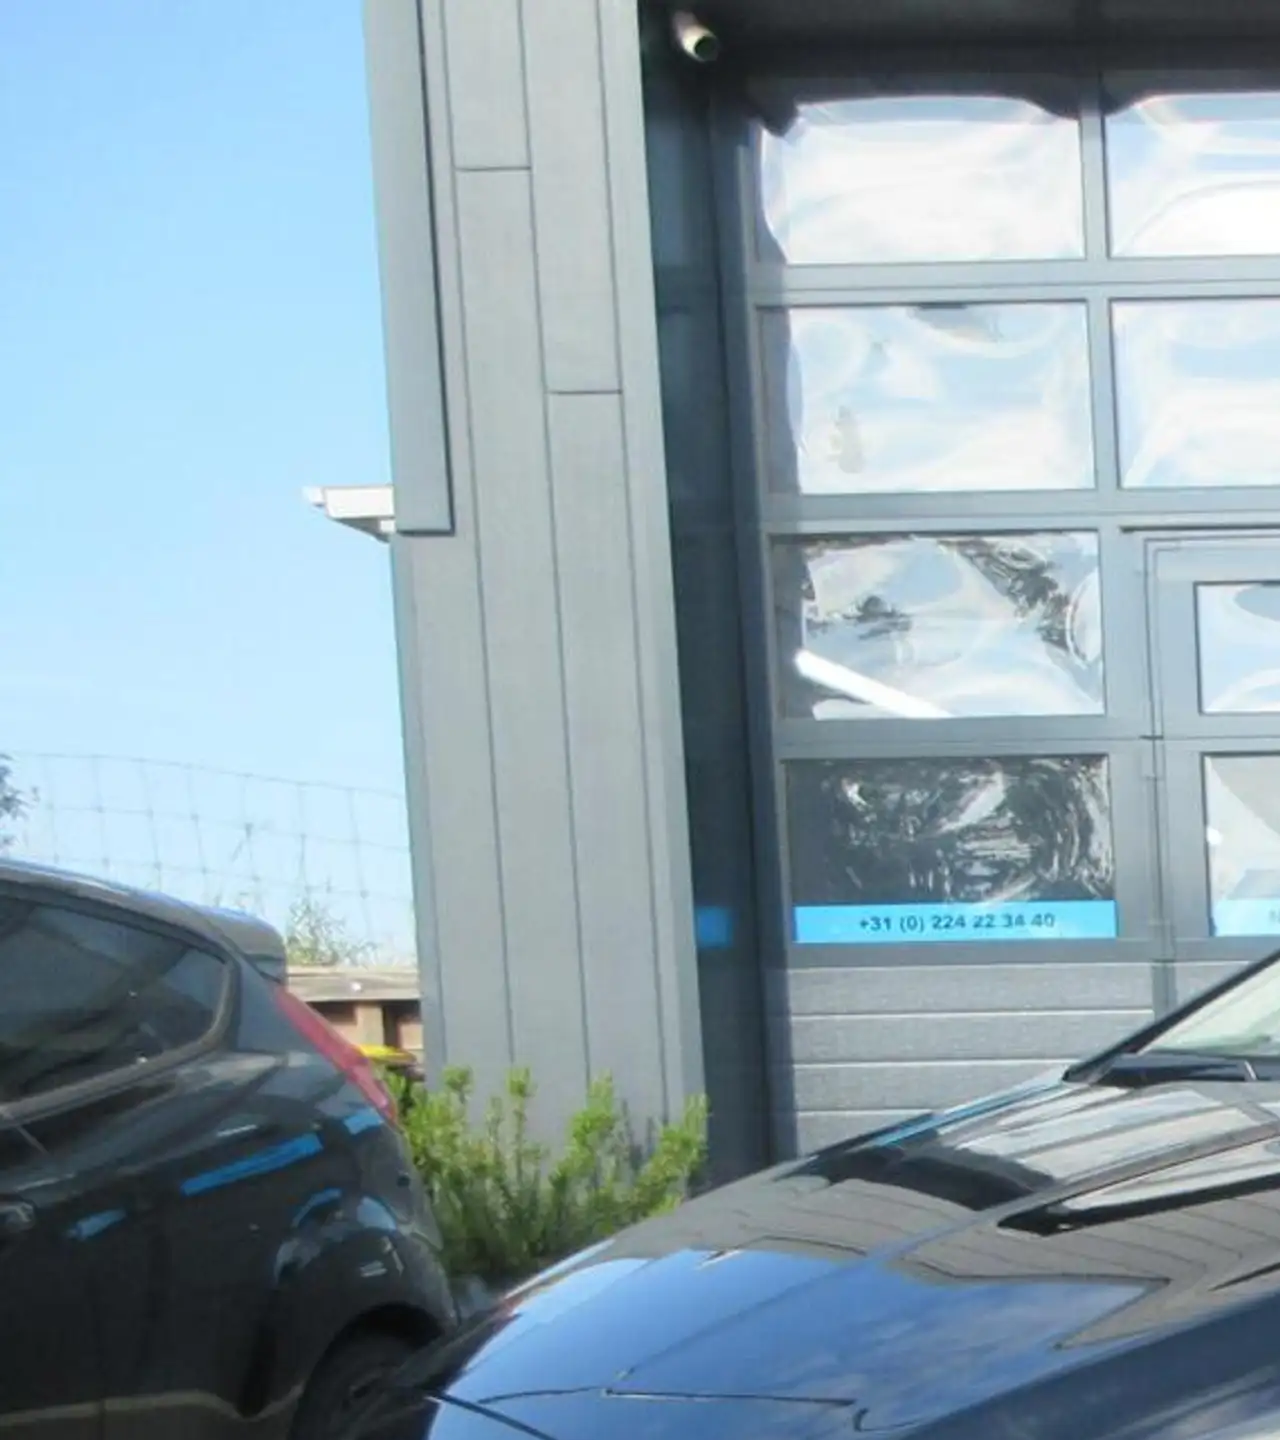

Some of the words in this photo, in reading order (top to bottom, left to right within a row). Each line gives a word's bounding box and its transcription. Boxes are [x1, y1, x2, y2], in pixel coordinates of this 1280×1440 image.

[859, 914, 891, 932] +31
[900, 914, 924, 934] (0)
[931, 913, 966, 931] 224
[972, 911, 995, 930] 22
[1031, 910, 1056, 929] 40
